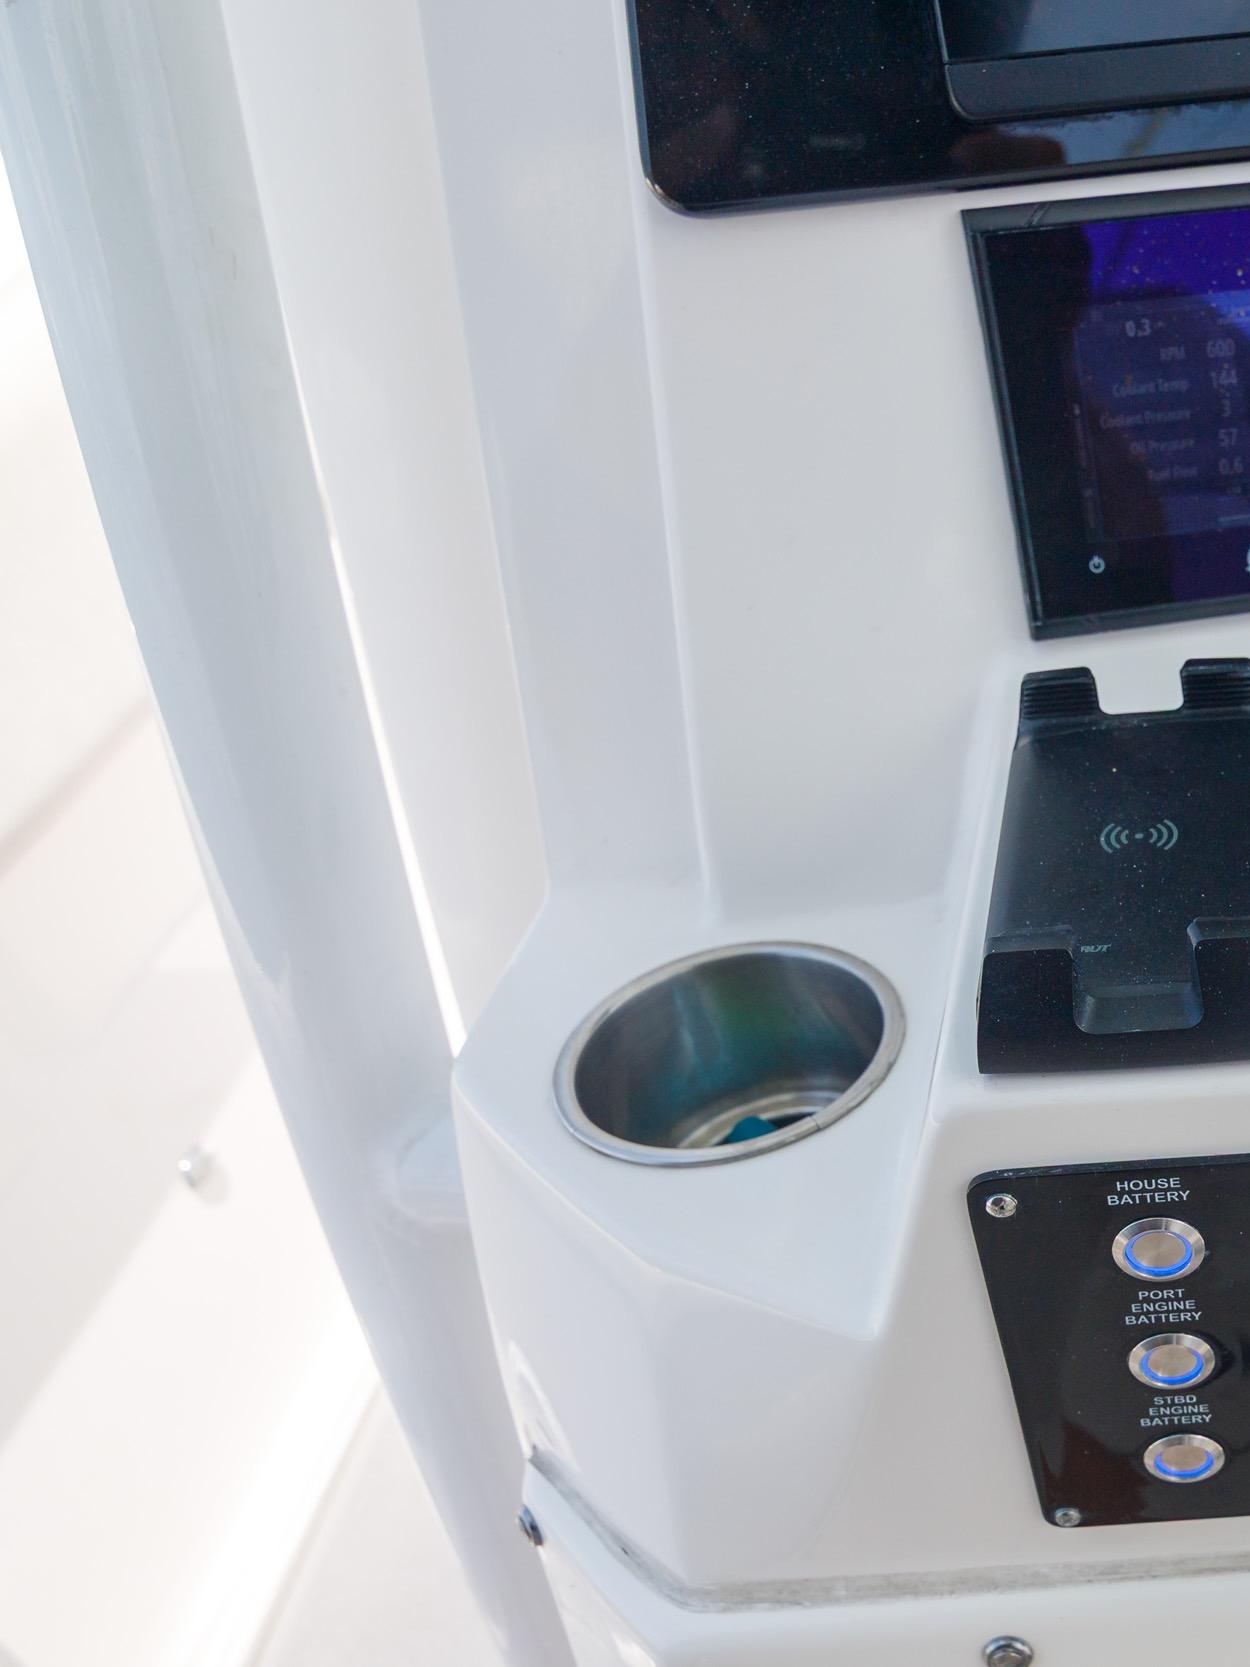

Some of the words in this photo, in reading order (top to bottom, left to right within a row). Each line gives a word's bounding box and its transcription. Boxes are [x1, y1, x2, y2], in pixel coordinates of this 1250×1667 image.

[1116, 1177, 1181, 1192] HOUSE
[1107, 1190, 1191, 1206] BATTERY
[1138, 1288, 1186, 1301] PORT
[1131, 1299, 1197, 1314] ENGINE
[1125, 1311, 1202, 1326] BATTERY
[1153, 1394, 1197, 1406] STBD
[1148, 1403, 1210, 1417] ENGINE
[1139, 1413, 1213, 1428] BATTERY
